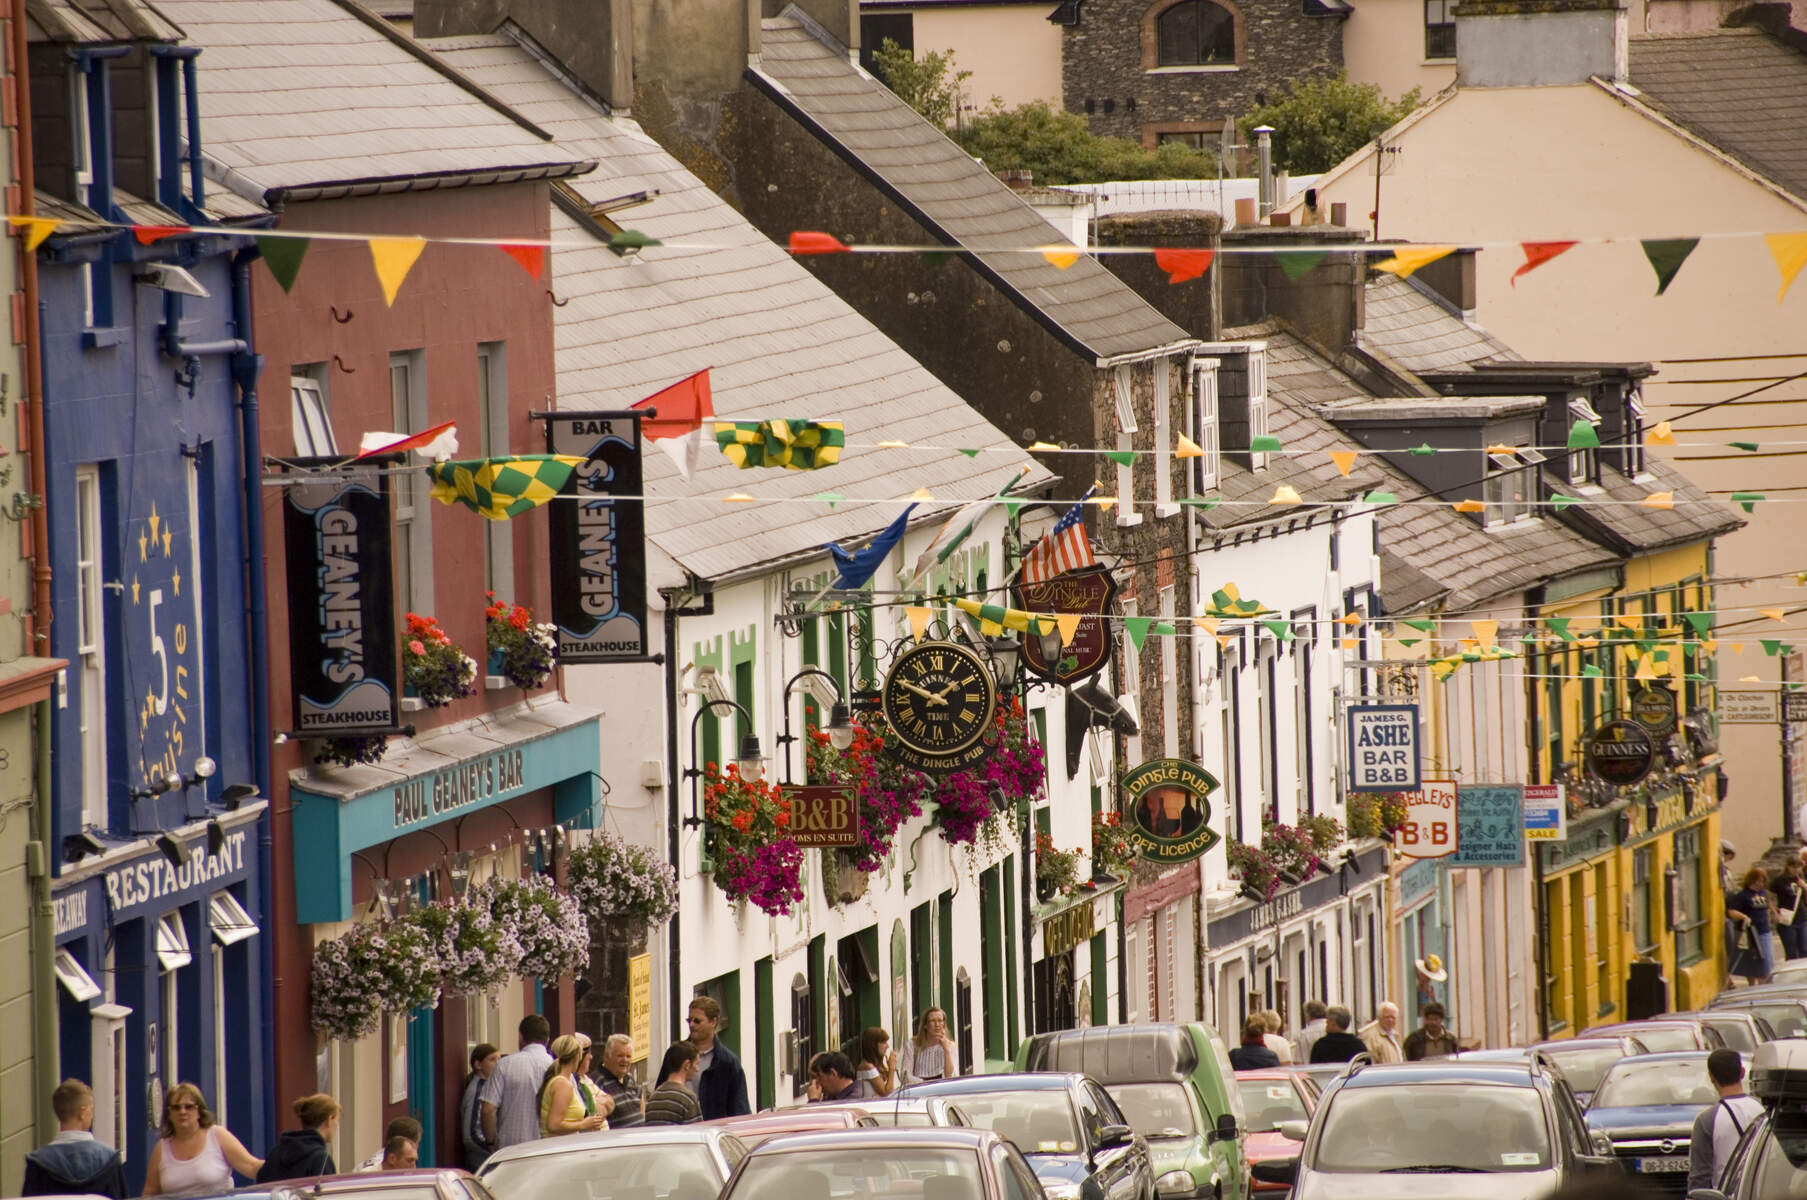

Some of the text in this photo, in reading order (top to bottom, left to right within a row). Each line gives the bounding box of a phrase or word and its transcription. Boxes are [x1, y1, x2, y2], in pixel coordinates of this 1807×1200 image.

[572, 421, 613, 435] BAR
[575, 459, 615, 617] GEANEY'S
[320, 509, 365, 684] GEANEY'S
[1029, 581, 1099, 604] DINGLE
[149, 589, 168, 716] 5
[561, 641, 640, 653] STEAKHOUSE
[302, 710, 390, 725] STEAKHOUSE
[927, 713, 949, 721] TIME
[1360, 714, 1396, 722] JAMES
[1358, 724, 1411, 747] ASHE
[900, 745, 985, 768] THE DINGLE PUB
[1592, 742, 1649, 756] GUINNESS
[1363, 751, 1407, 765] BAR
[1181, 770, 1210, 794] PUB
[1365, 768, 1408, 783] B&B
[394, 780, 428, 829] PAUL
[498, 749, 523, 794] BAR
[791, 798, 848, 831] B&B
[814, 833, 826, 842] EN
[828, 833, 855, 842] SUITE
[1528, 830, 1557, 838] SALE
[1131, 833, 1158, 852] OFF
[1460, 841, 1517, 853] esigner Hats
[1464, 852, 1516, 861] Accessories
[106, 831, 245, 911] RESTAURANT
